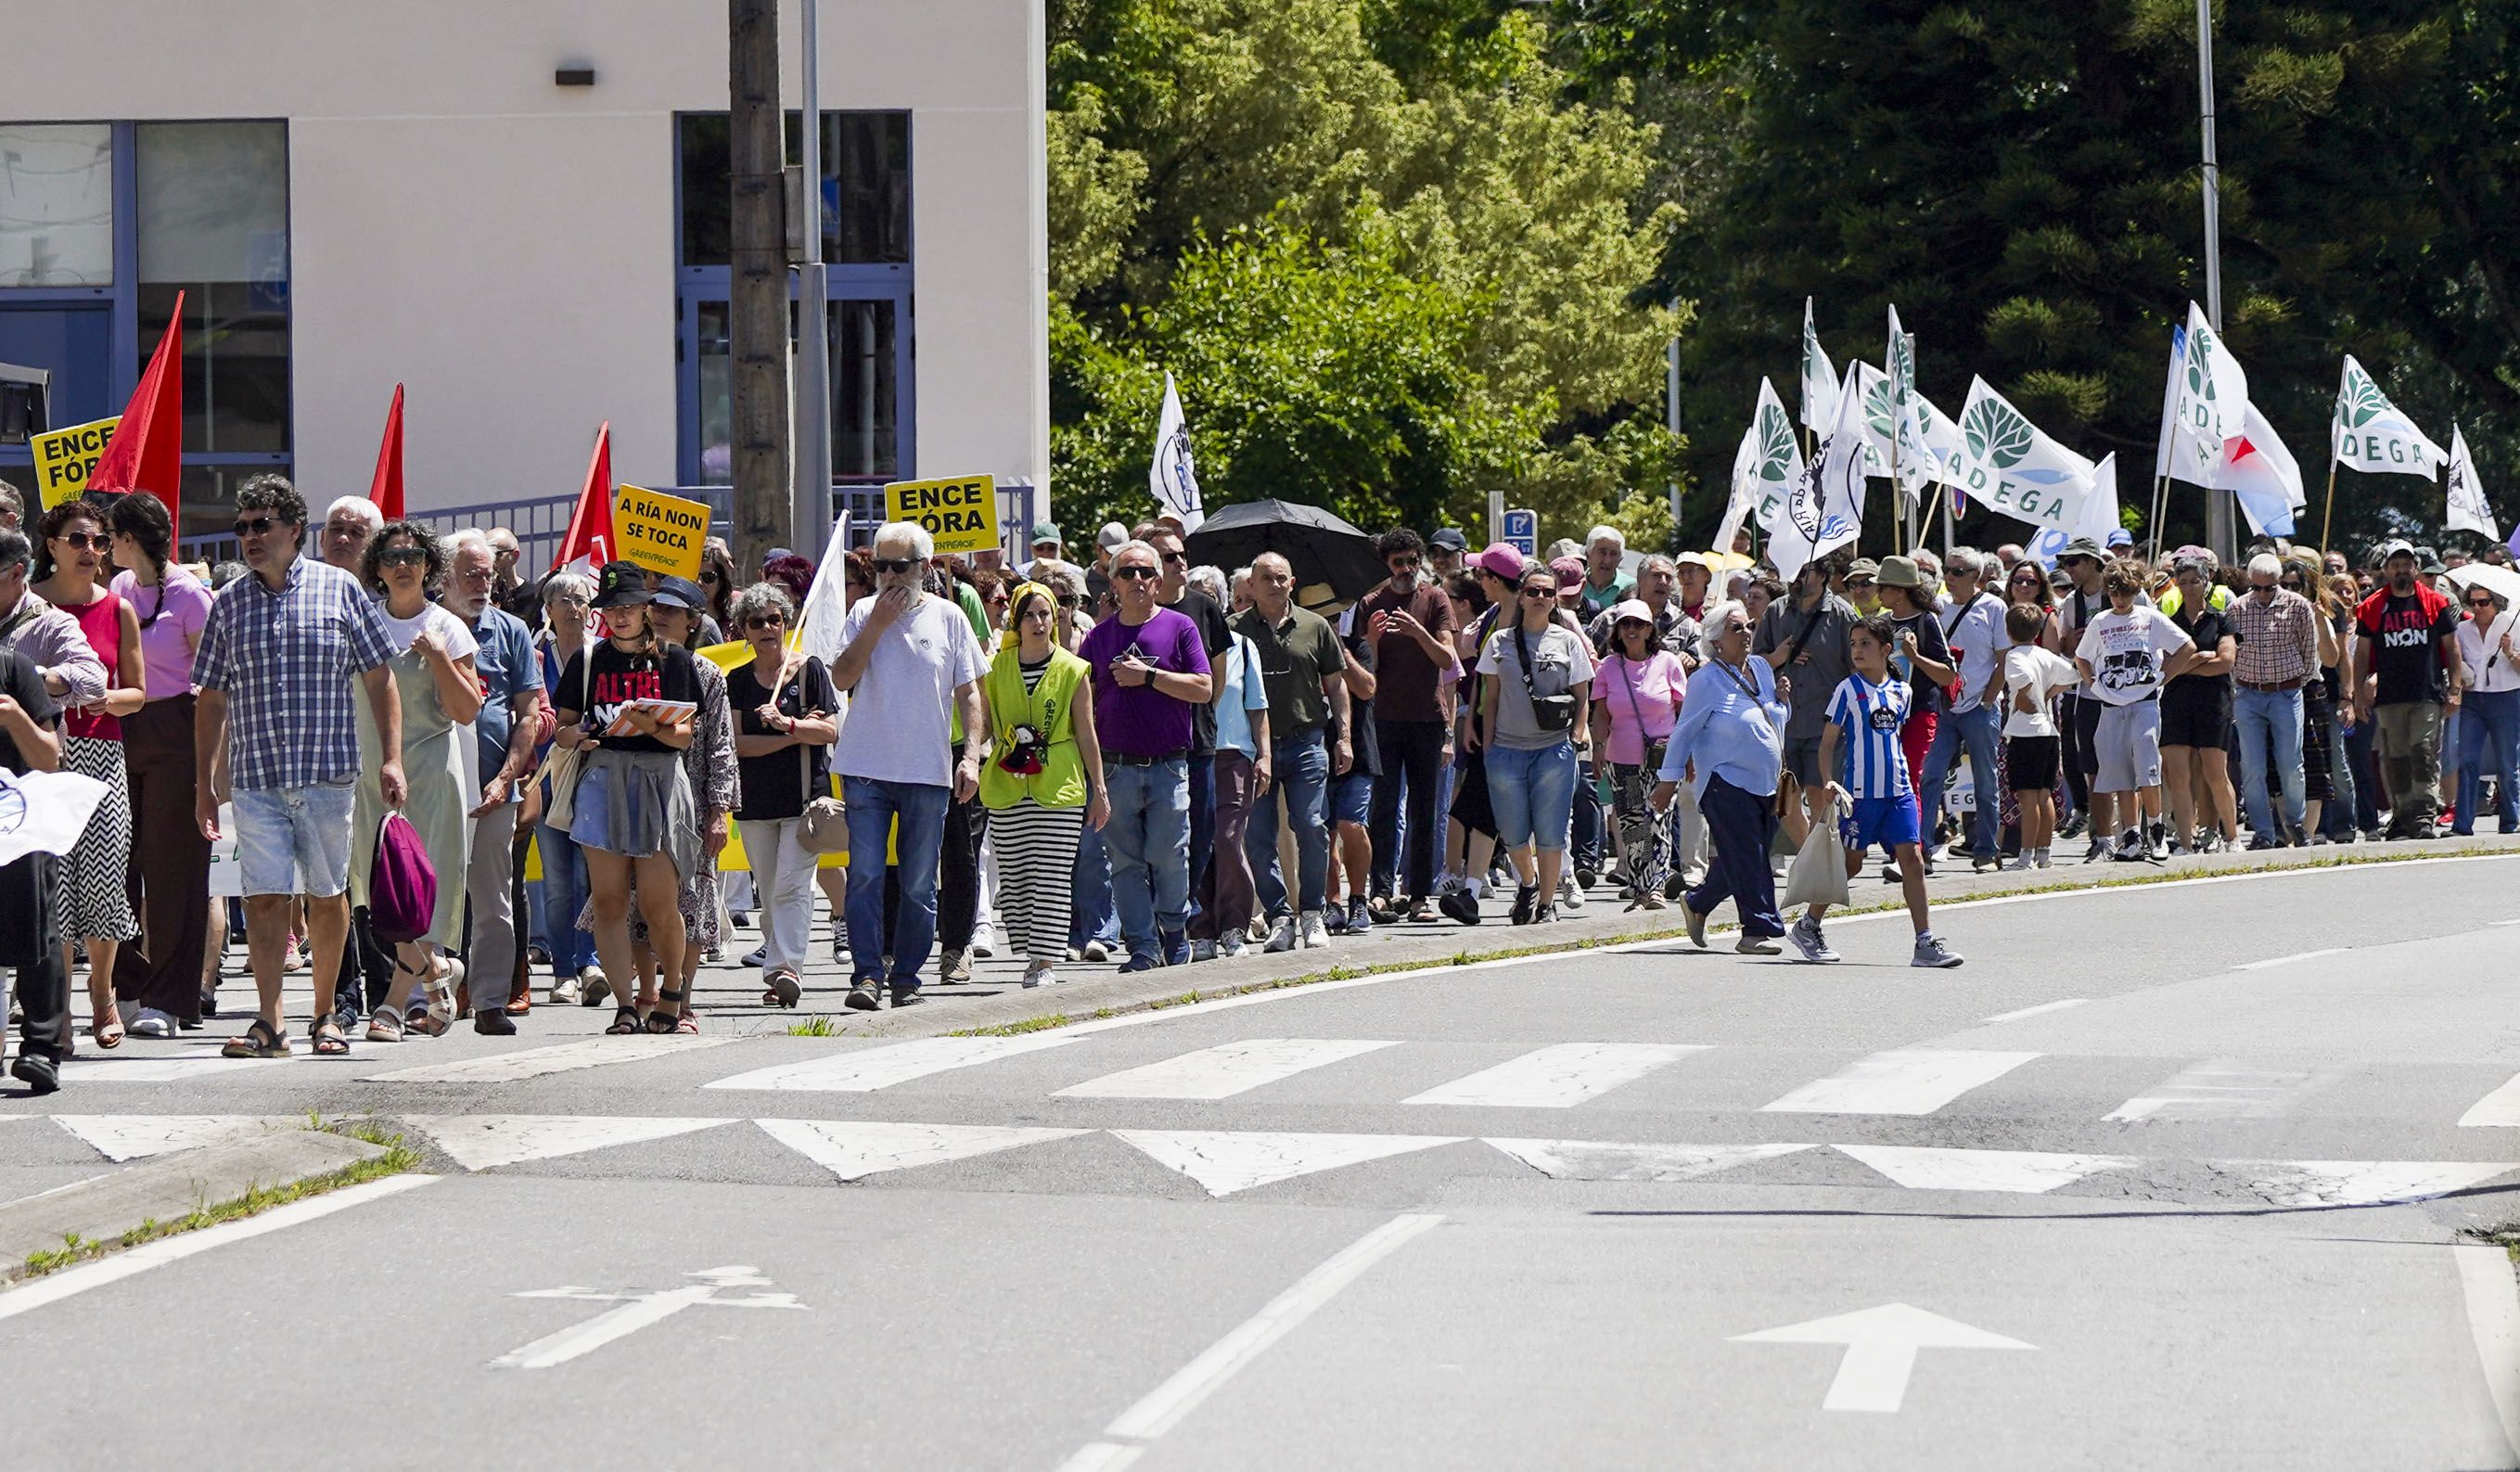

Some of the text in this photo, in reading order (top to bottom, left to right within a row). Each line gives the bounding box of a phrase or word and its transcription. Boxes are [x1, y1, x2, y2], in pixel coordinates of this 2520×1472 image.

[44, 426, 115, 461] ENCE
[2341, 434, 2426, 467] DEGA
[49, 455, 99, 488] FÓR
[900, 482, 982, 511] ENCE
[1949, 453, 2064, 521] ADEGA
[620, 498, 702, 531] A RÍA NON
[902, 509, 986, 534] ÓRA
[626, 522, 688, 550] SE TOCA
[933, 539, 977, 551] ENPEACE
[2385, 610, 2427, 632] ALTRI
[2384, 628, 2428, 647] NON
[595, 670, 661, 703] ALTRI
[1951, 793, 1975, 805] EG
